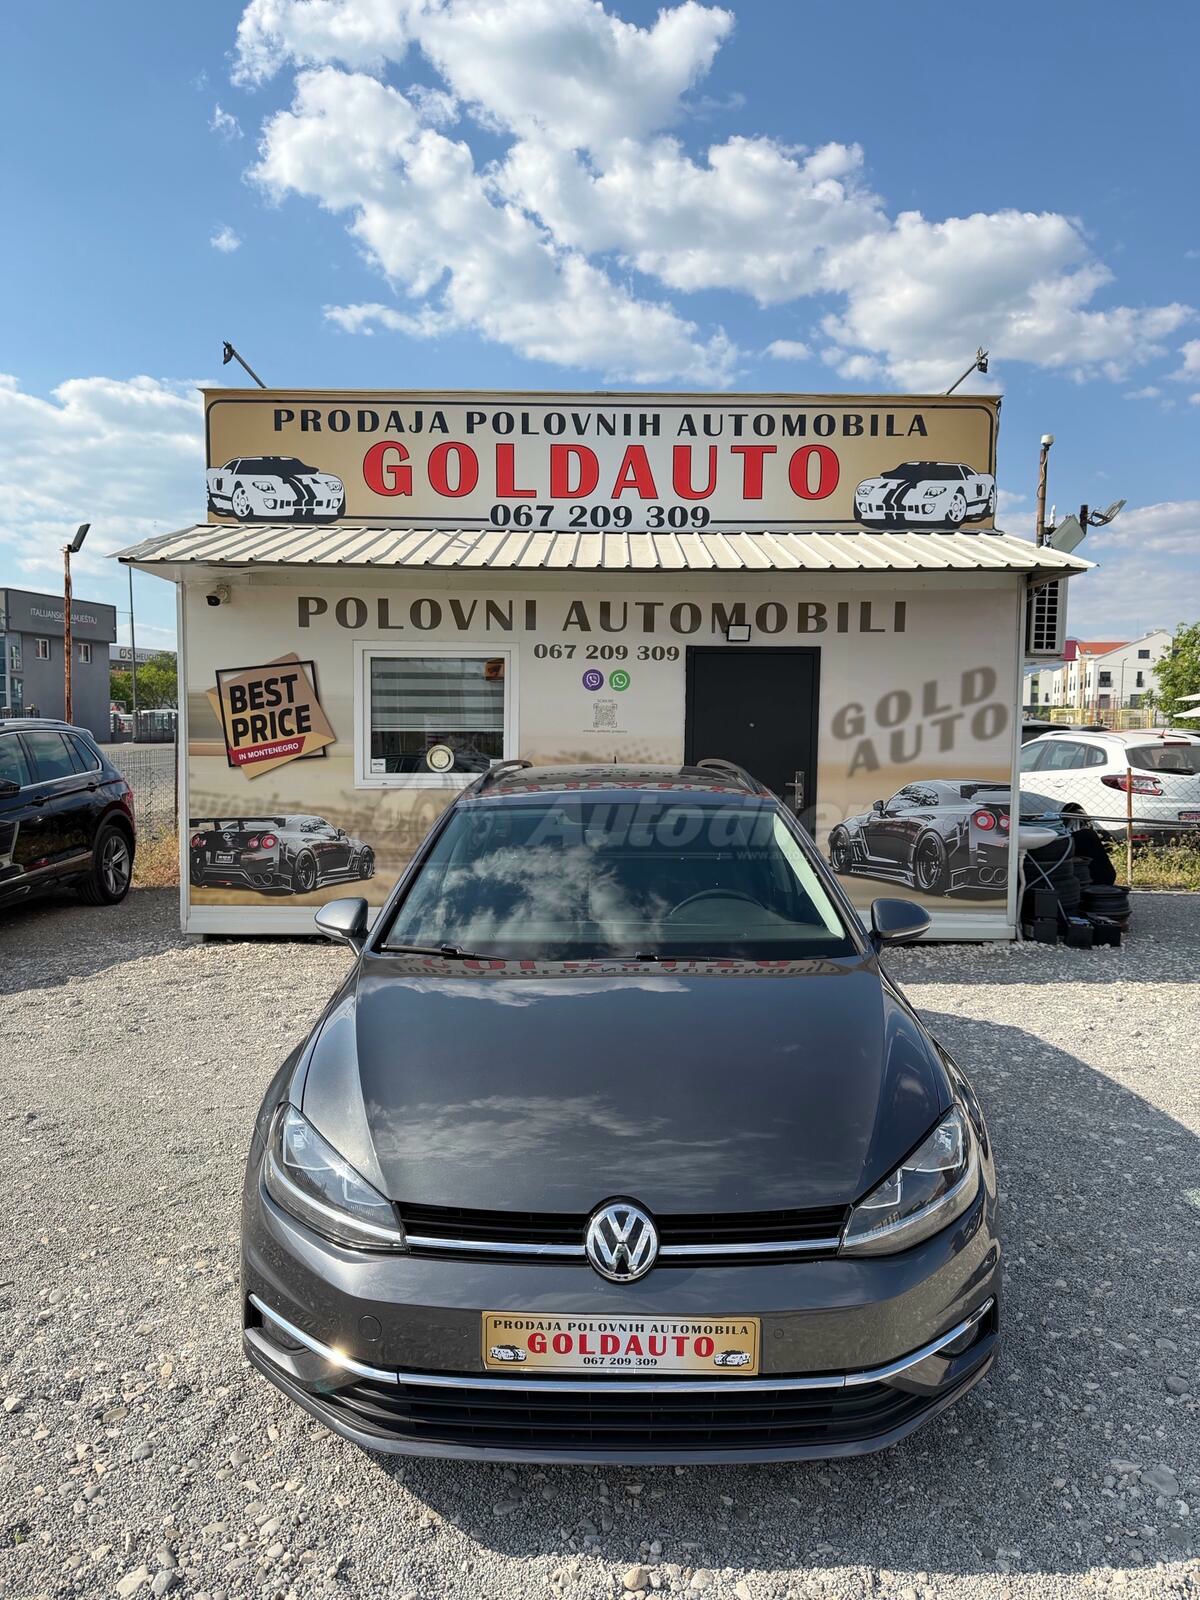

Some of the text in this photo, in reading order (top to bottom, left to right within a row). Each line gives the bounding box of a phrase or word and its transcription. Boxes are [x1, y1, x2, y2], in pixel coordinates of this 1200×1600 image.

[273, 408, 929, 437] PRODAJA POLOVNIH AUTOMOBILA
[362, 439, 840, 501] GOLDAUTO
[490, 503, 711, 528] 067 209 309
[297, 596, 906, 634] POLOVNI AUTOMOBILI
[533, 644, 680, 661] 067 209 309
[229, 674, 298, 714] BEST
[831, 666, 997, 741] GOLD
[231, 704, 312, 747] PRICE
[847, 702, 1008, 778] AUTO
[238, 742, 299, 761] IN MONTENEGRO
[587, 1203, 658, 1282] VW
[493, 1319, 749, 1335] PRODAJA POLOVNIH AUTOMOBILA
[527, 1332, 715, 1358] GOLDAUTO
[583, 1356, 658, 1367] 067 209 309
